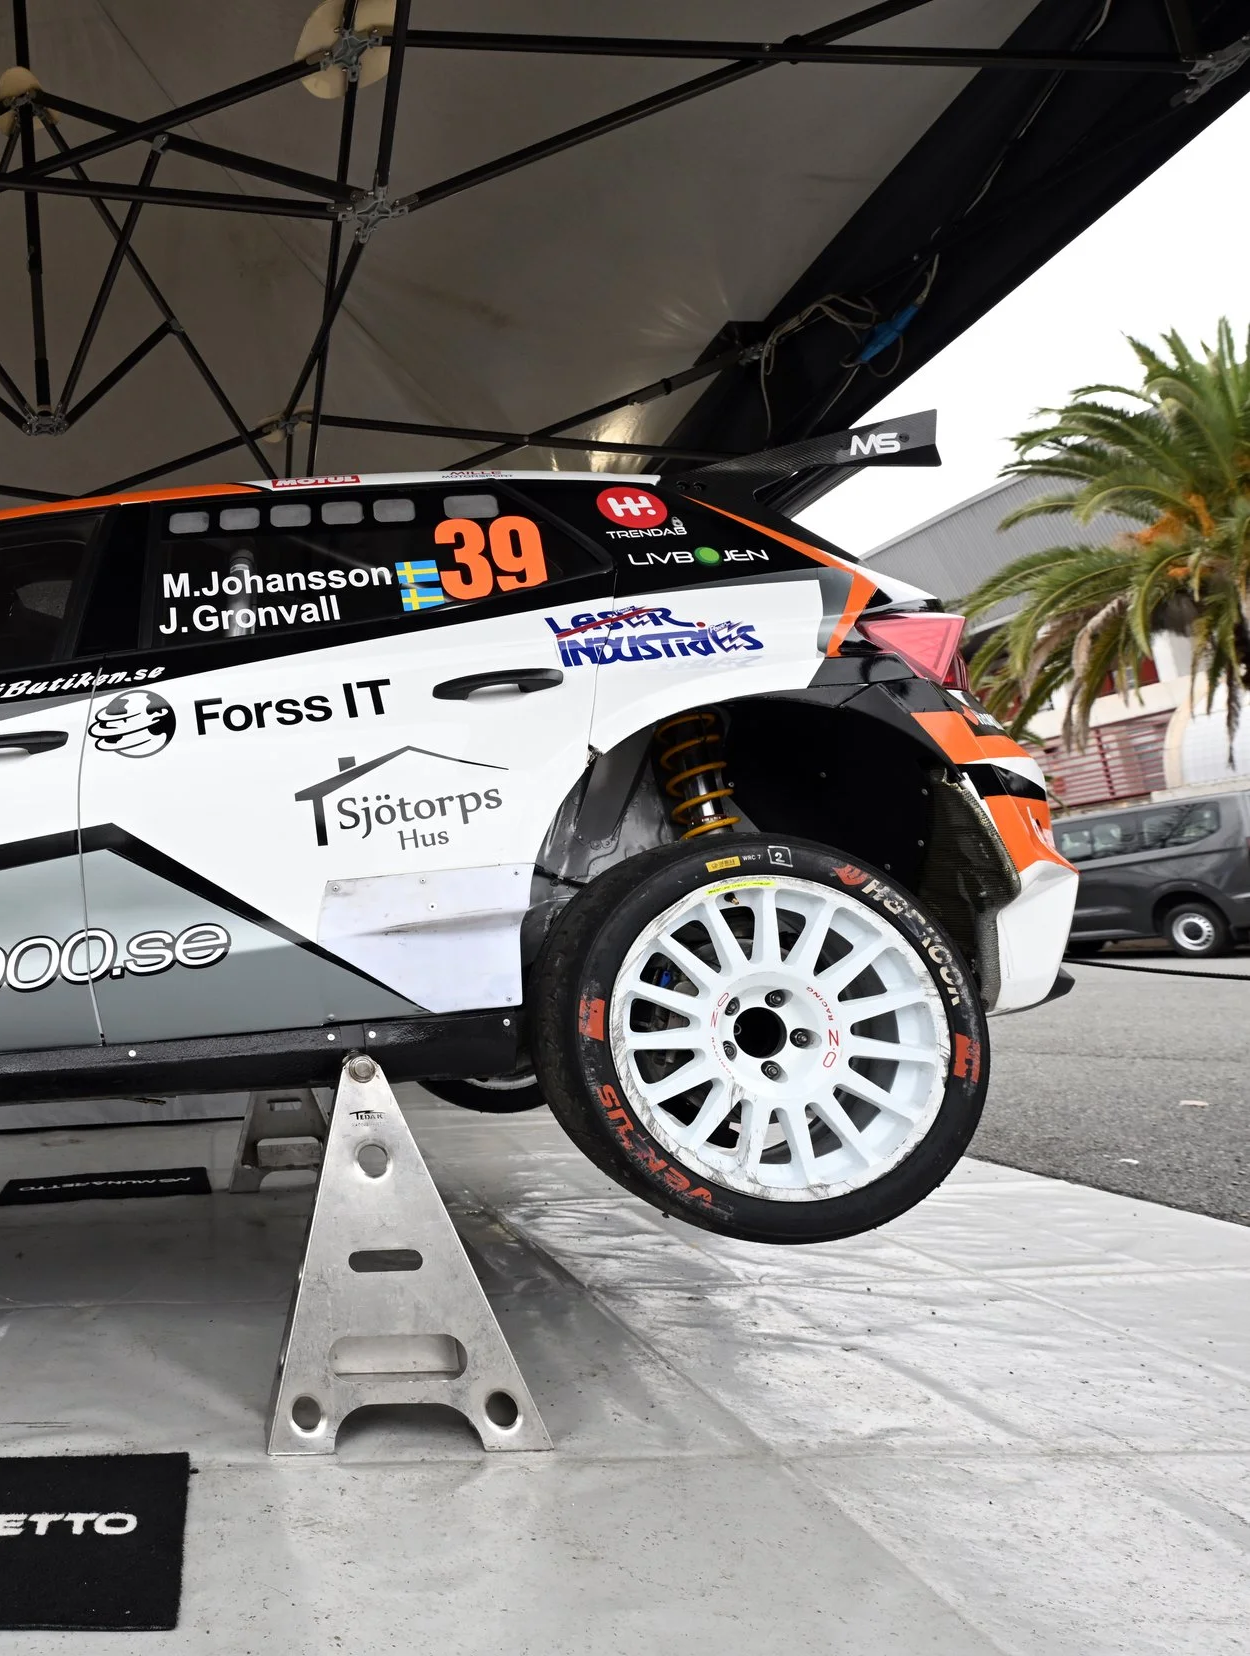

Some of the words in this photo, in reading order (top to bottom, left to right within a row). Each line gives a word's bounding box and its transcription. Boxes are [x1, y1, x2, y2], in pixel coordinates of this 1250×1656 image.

[850, 433, 901, 455] MS
[275, 476, 357, 486] MOTUL
[606, 527, 688, 539] TRENDAB
[433, 515, 548, 601] 39
[194, 695, 333, 736] Forss
[343, 679, 391, 718] IT
[336, 784, 504, 840] Sjötorps
[397, 829, 451, 851] Hus
